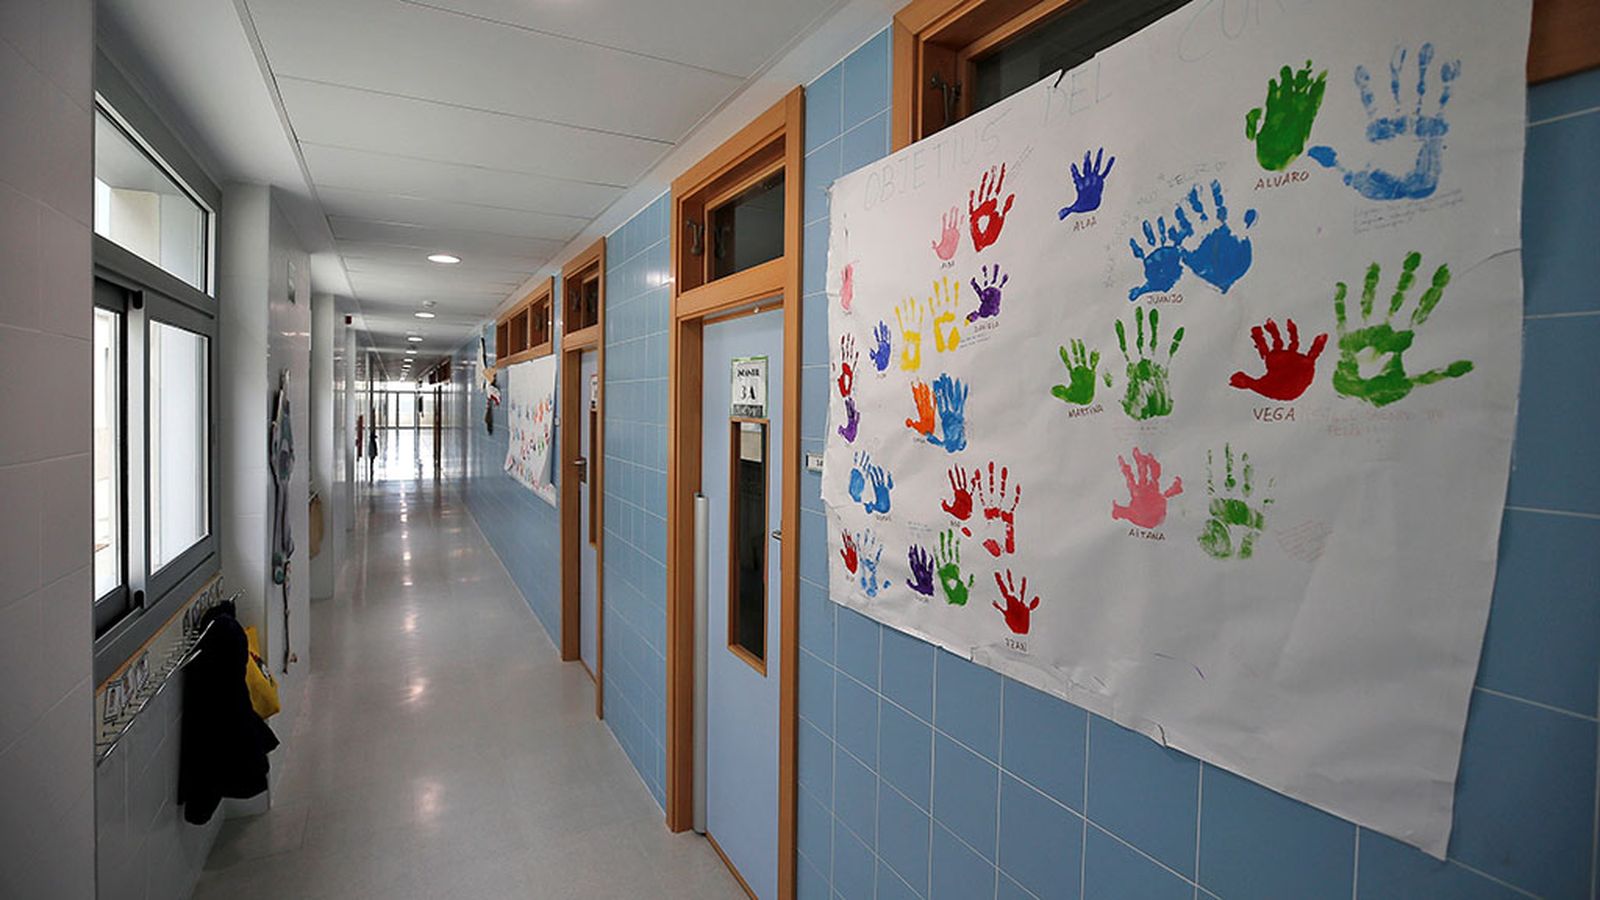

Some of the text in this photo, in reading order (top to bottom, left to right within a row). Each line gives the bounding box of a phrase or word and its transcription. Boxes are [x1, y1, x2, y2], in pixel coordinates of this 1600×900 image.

[1254, 171, 1310, 191] ALVARO
[1067, 403, 1104, 418] MARTINA
[1253, 407, 1296, 422] VEGA
[1127, 528, 1167, 541] AITANA
